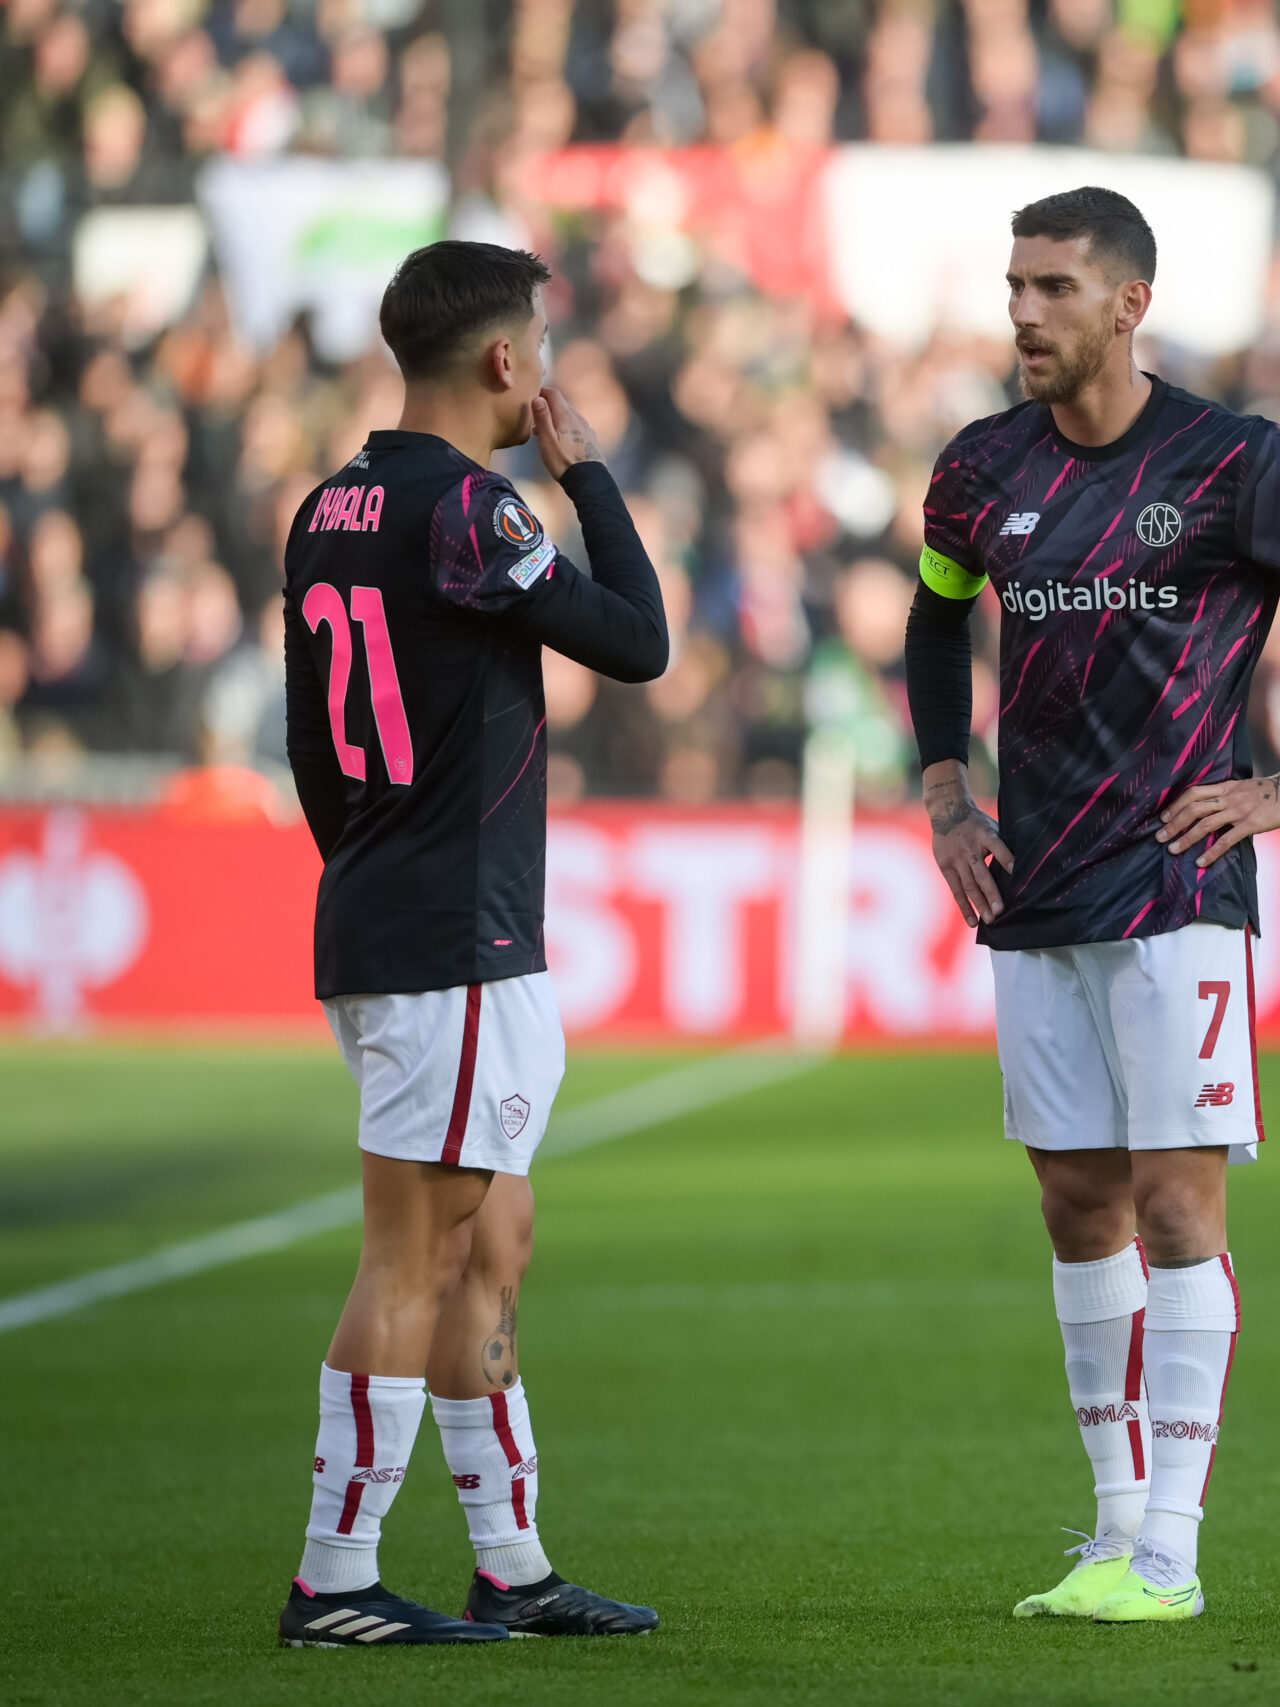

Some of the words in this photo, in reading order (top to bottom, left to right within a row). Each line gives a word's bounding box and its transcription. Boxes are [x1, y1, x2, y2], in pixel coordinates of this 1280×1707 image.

[308, 485, 385, 532] DYBALA
[1000, 512, 1041, 535] NB
[924, 550, 950, 575] PECT
[1002, 577, 1178, 621] digitalbits
[302, 582, 414, 786] 21
[1198, 980, 1231, 1059] 7
[1194, 1082, 1235, 1108] NB
[1077, 1402, 1138, 1427] OMA
